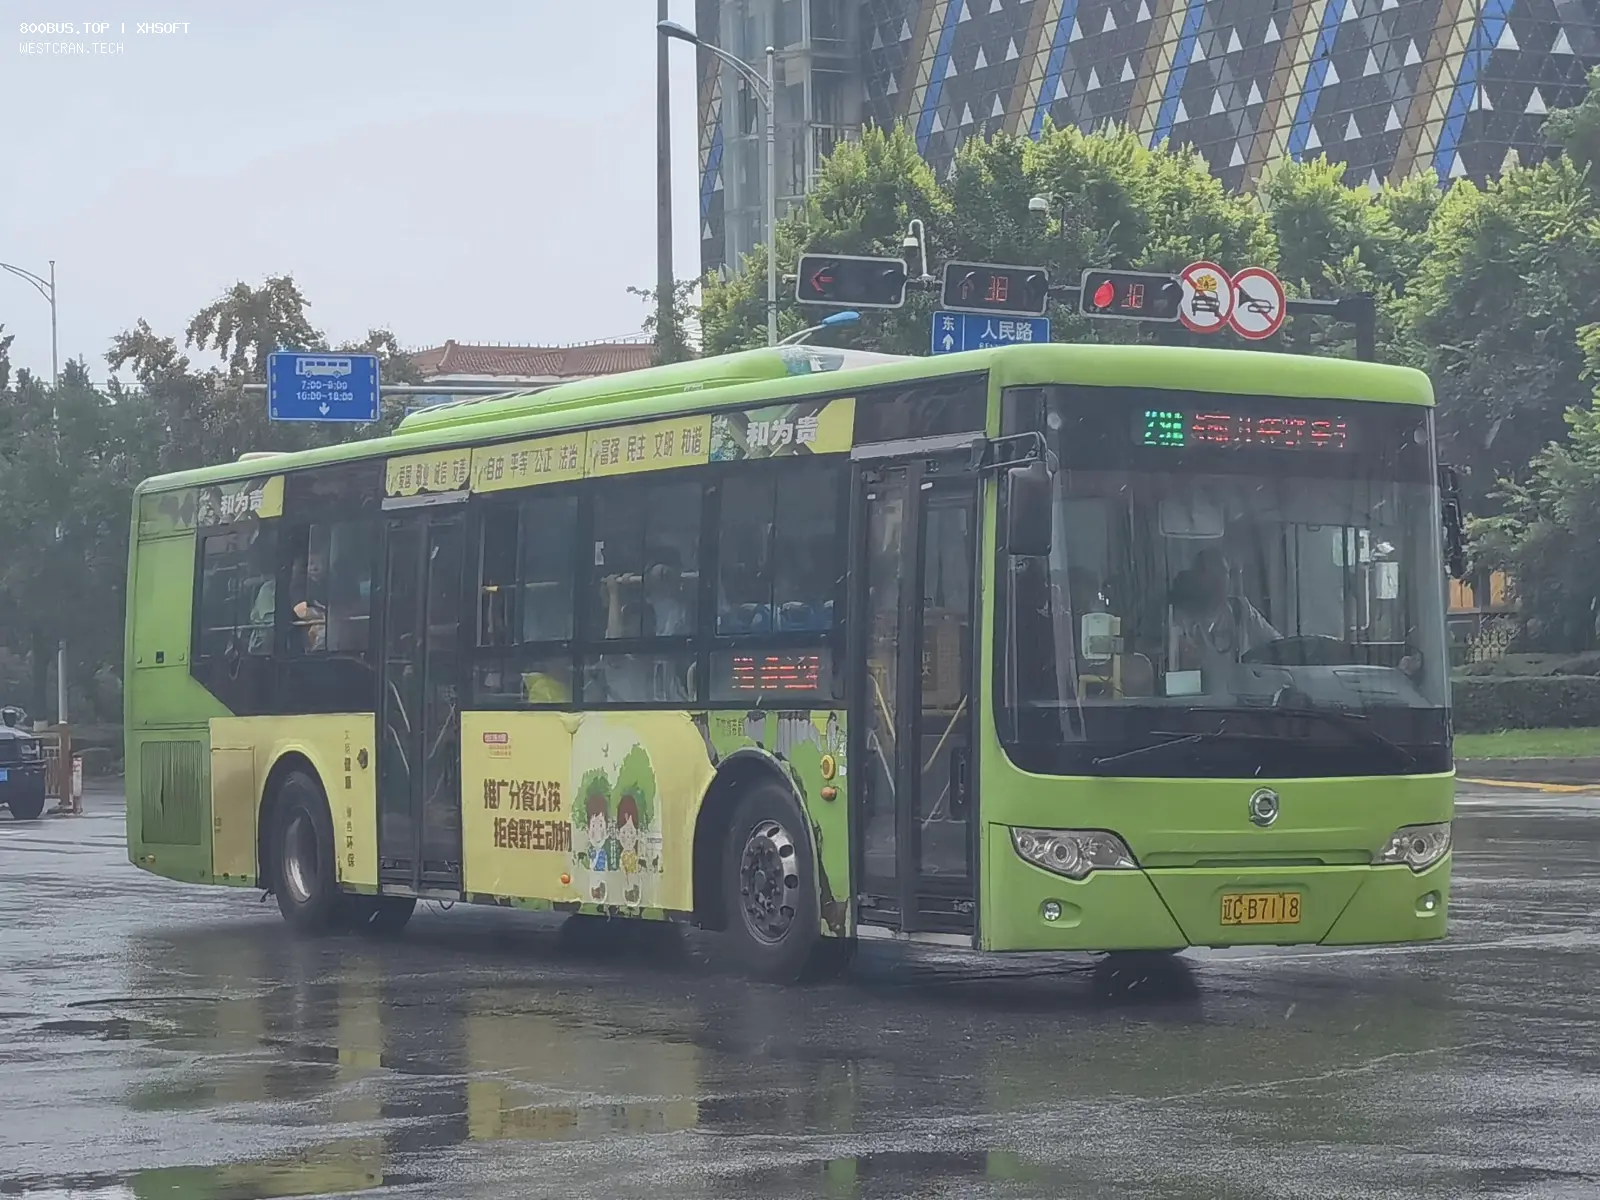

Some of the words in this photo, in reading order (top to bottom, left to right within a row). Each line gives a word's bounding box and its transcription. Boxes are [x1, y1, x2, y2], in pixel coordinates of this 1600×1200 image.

[941, 316, 956, 332] 东
[980, 319, 1034, 342] 人民路
[600, 437, 621, 466] 富强
[626, 433, 647, 463] 民主
[653, 431, 675, 459] 文明
[680, 425, 703, 456] 和谐
[746, 415, 819, 447] 和为贵
[486, 456, 504, 482] 自由
[509, 452, 529, 478] 平等
[534, 447, 553, 473] 公正
[558, 443, 578, 470] 法治
[483, 778, 562, 813] 推广分餐公筷
[493, 816, 573, 853] 拒食野生动物
